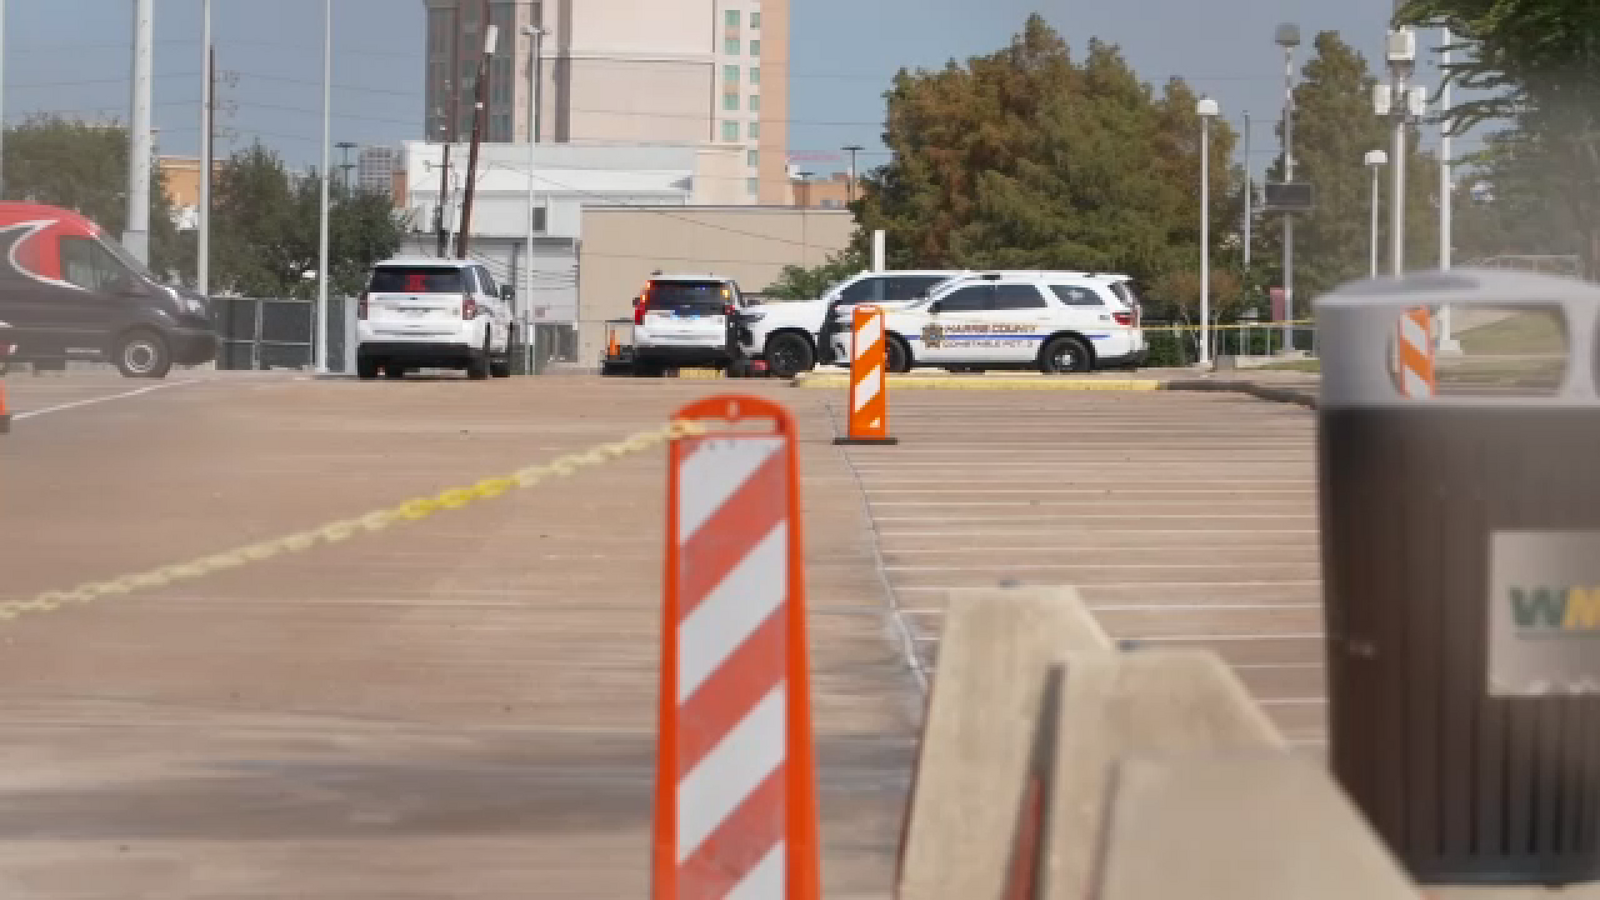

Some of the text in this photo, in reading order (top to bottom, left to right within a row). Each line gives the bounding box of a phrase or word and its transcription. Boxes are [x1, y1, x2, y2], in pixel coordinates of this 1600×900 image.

[944, 324, 1036, 333] HARRIS COUNTY
[1510, 587, 1600, 630] WM
